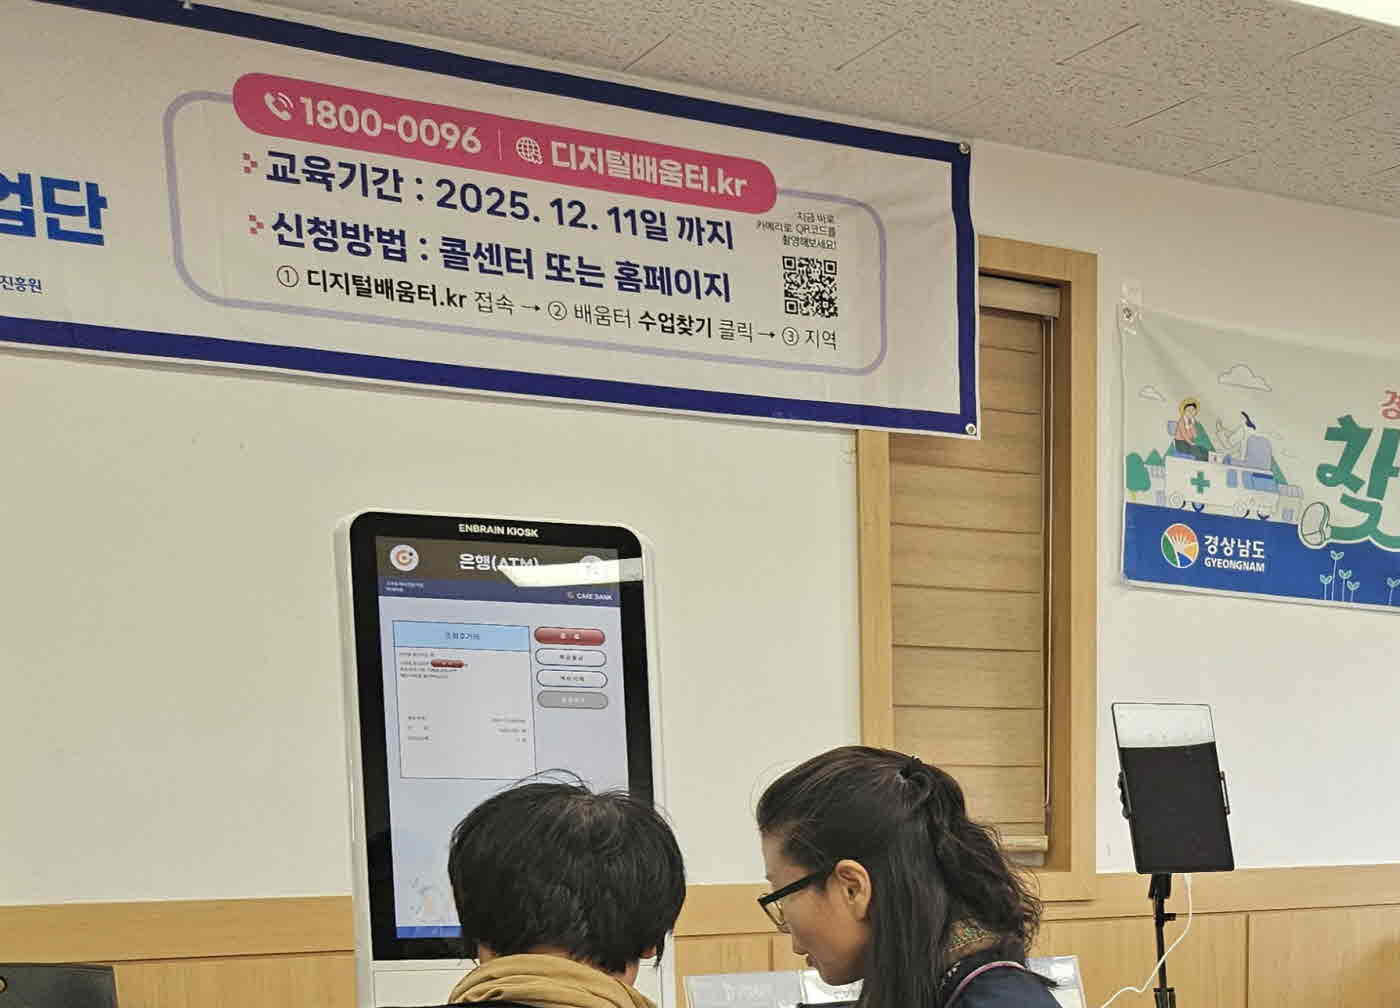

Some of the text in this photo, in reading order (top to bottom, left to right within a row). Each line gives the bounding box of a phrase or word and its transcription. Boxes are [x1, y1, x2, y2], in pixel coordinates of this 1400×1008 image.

[300, 96, 748, 198] 1800-0096 디지털배움터.kr
[266, 150, 404, 203] 교육기간
[435, 178, 541, 223] 2025.
[550, 198, 598, 230] 12.
[607, 206, 669, 242] 11일
[677, 215, 733, 250] 까지
[272, 212, 407, 263] 신청방법
[439, 235, 534, 280] 콜센터
[545, 252, 605, 289] 또는
[614, 260, 730, 303] 홈페이지
[306, 269, 467, 308] 디지털배움터.kr
[473, 290, 515, 316] 접속
[574, 303, 632, 329] 배움터
[638, 310, 713, 338] 수업찾기
[719, 319, 754, 343] 클릭
[805, 329, 837, 350] 지역
[458, 523, 539, 539] ENBRAIN KIOSK
[1204, 535, 1265, 559] 경상남도
[1204, 556, 1265, 573] GYEONGNAM
